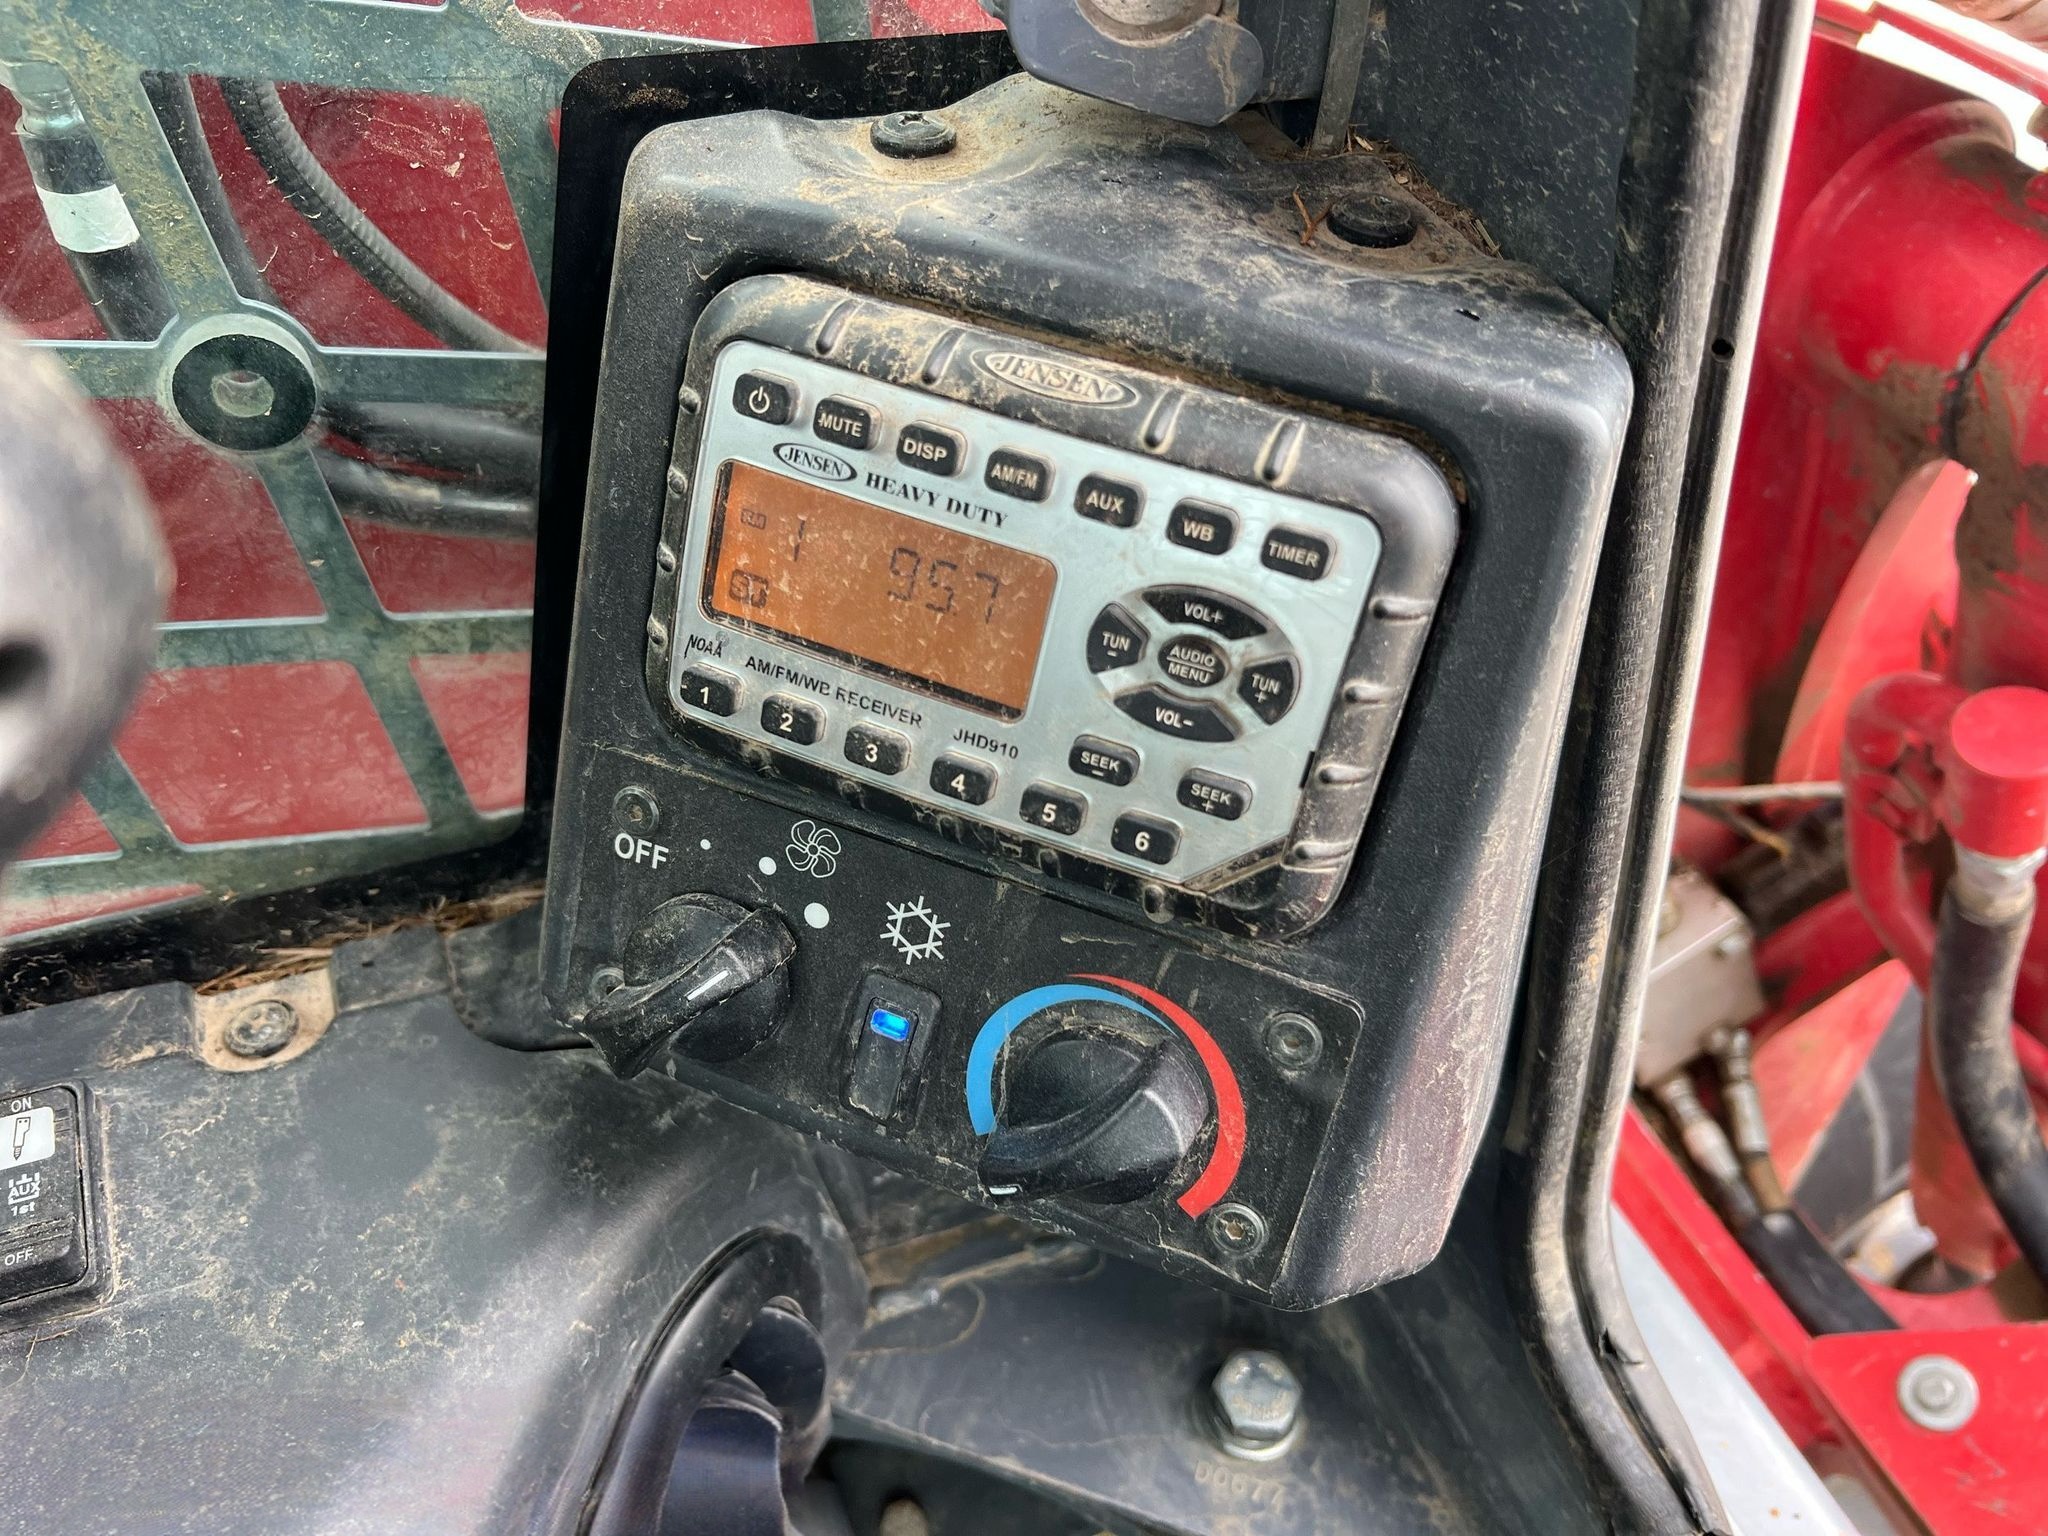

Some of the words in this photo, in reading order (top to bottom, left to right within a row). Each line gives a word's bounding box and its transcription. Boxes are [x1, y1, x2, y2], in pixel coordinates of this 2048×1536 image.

[998, 354, 1108, 399] JENSEN
[818, 413, 862, 439] MUTE
[903, 437, 947, 463] DISP
[784, 447, 844, 477] JENSEN
[990, 462, 1038, 491] AM/FM
[866, 472, 941, 513] HEAVY
[946, 497, 1009, 530] DUTY
[1086, 491, 1124, 515] AUX
[1183, 519, 1214, 543] WB
[1268, 541, 1320, 569] TIMER
[684, 634, 724, 659] NOAA
[1102, 631, 1131, 652] TUN
[1169, 645, 1216, 668] AUDIO
[1168, 662, 1211, 685] MENU
[1251, 673, 1280, 695] TUN
[700, 686, 710, 704] 1
[835, 686, 923, 729] RECEIVER
[779, 713, 794, 732] 2
[864, 744, 879, 763] 3
[952, 728, 1020, 760] JHD910
[1079, 751, 1121, 772] SEEK
[950, 773, 966, 793] 4
[1190, 782, 1233, 804] SEEK
[1042, 803, 1057, 823] 5
[614, 832, 669, 869] OFF
[1134, 831, 1150, 851] 6
[11, 1096, 32, 1112] ON
[8, 1181, 41, 1198] AUX
[11, 1201, 36, 1216] 1st
[4, 1249, 35, 1266] OFF
